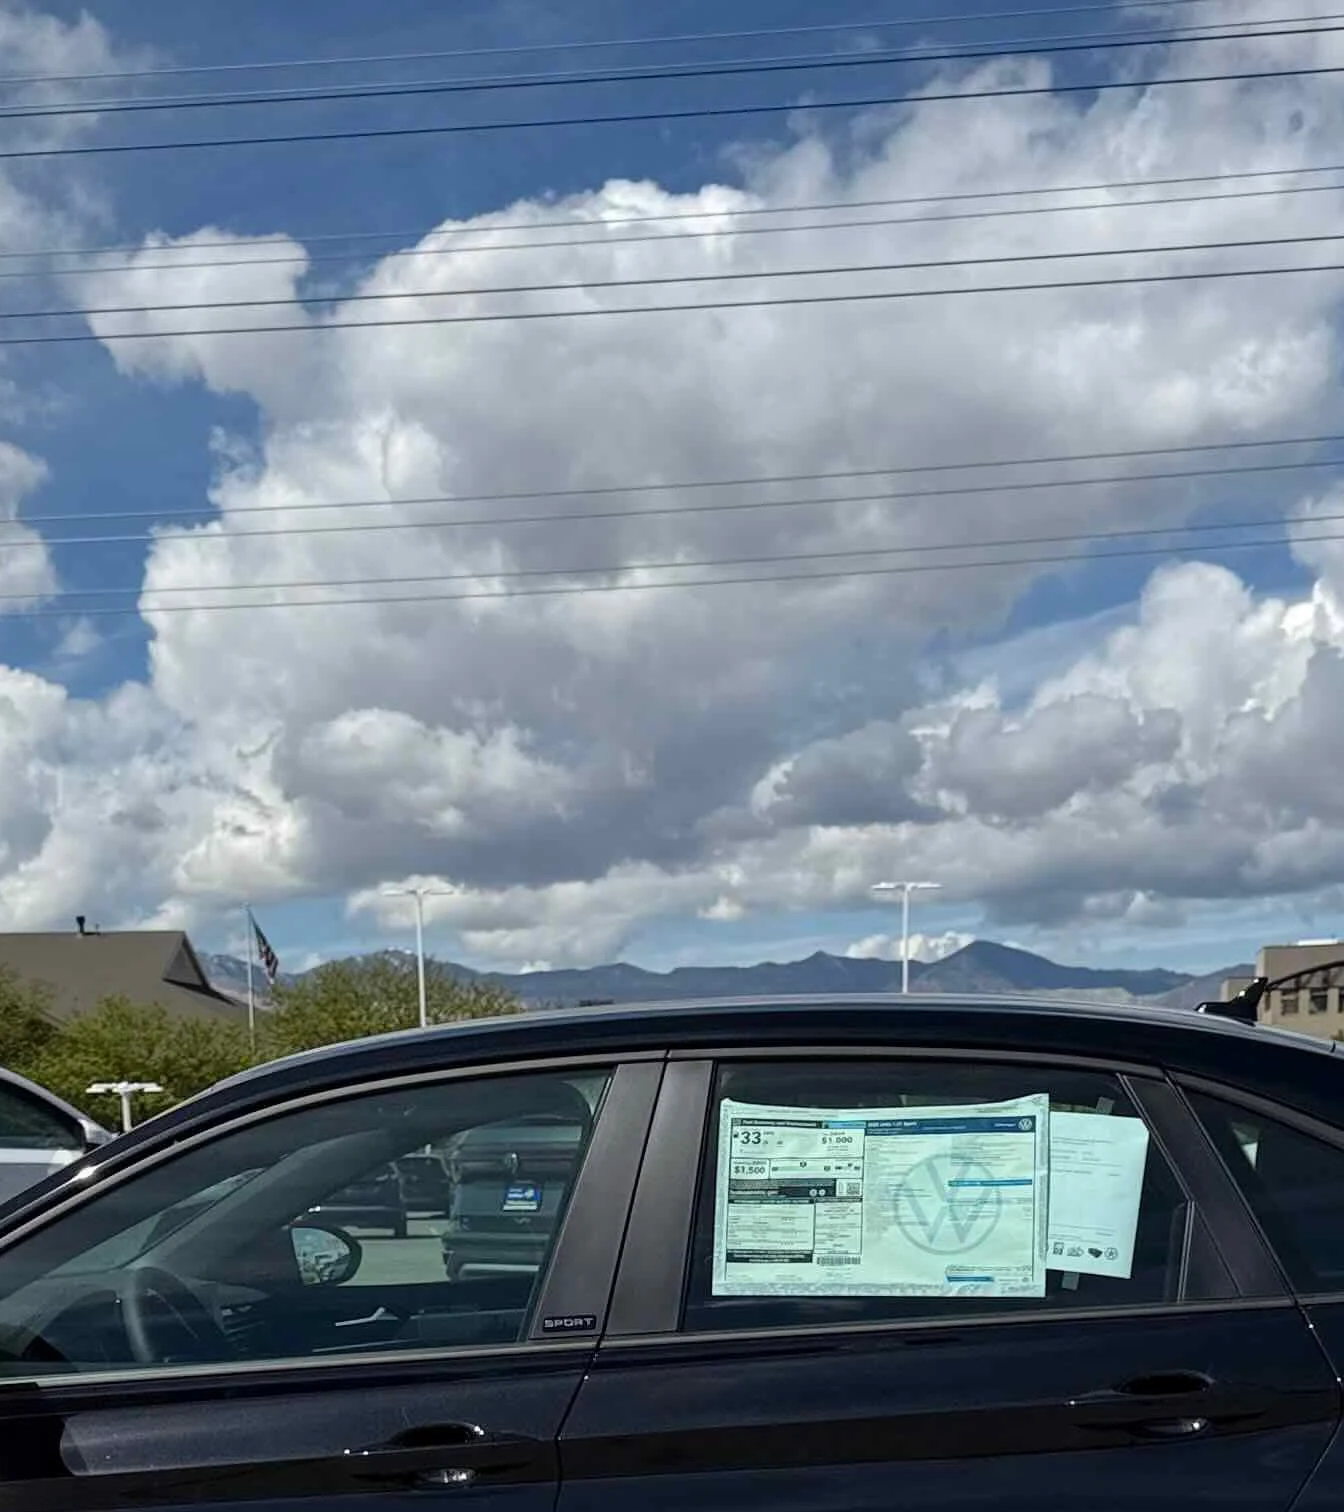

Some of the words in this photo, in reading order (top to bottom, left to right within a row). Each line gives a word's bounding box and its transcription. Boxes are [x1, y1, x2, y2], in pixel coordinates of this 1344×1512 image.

[740, 1131, 762, 1145] 33
[734, 1165, 766, 1175] $1,500
[544, 1317, 594, 1328] SPORT
